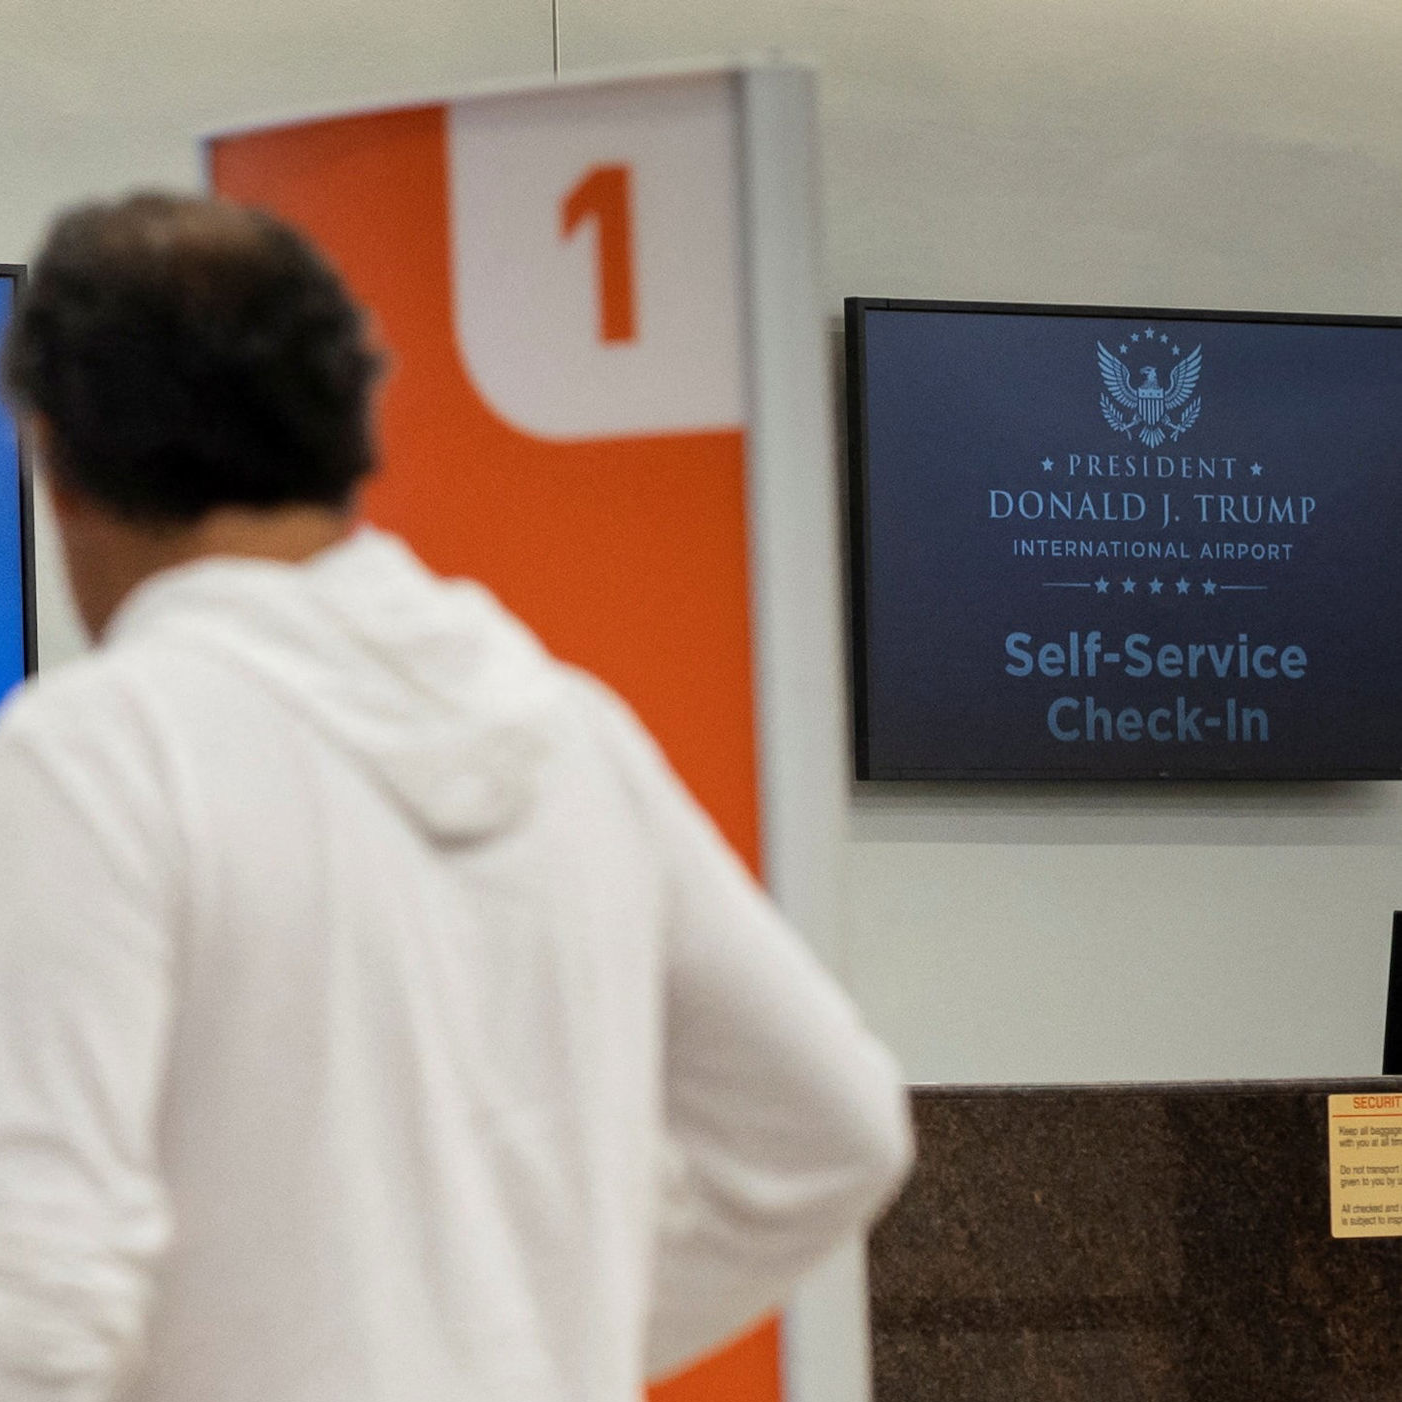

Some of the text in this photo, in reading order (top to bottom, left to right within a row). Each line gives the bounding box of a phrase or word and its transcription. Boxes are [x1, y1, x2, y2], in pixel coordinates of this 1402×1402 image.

[559, 161, 639, 346] 1
[1069, 454, 1237, 479] PRESIDENT
[988, 489, 1316, 529] DONALD J. TRUMP
[1013, 539, 1294, 561] INTERNATIONAL AIRPORT
[1004, 631, 1308, 679] Self-Service
[1047, 696, 1269, 742] Check-In
